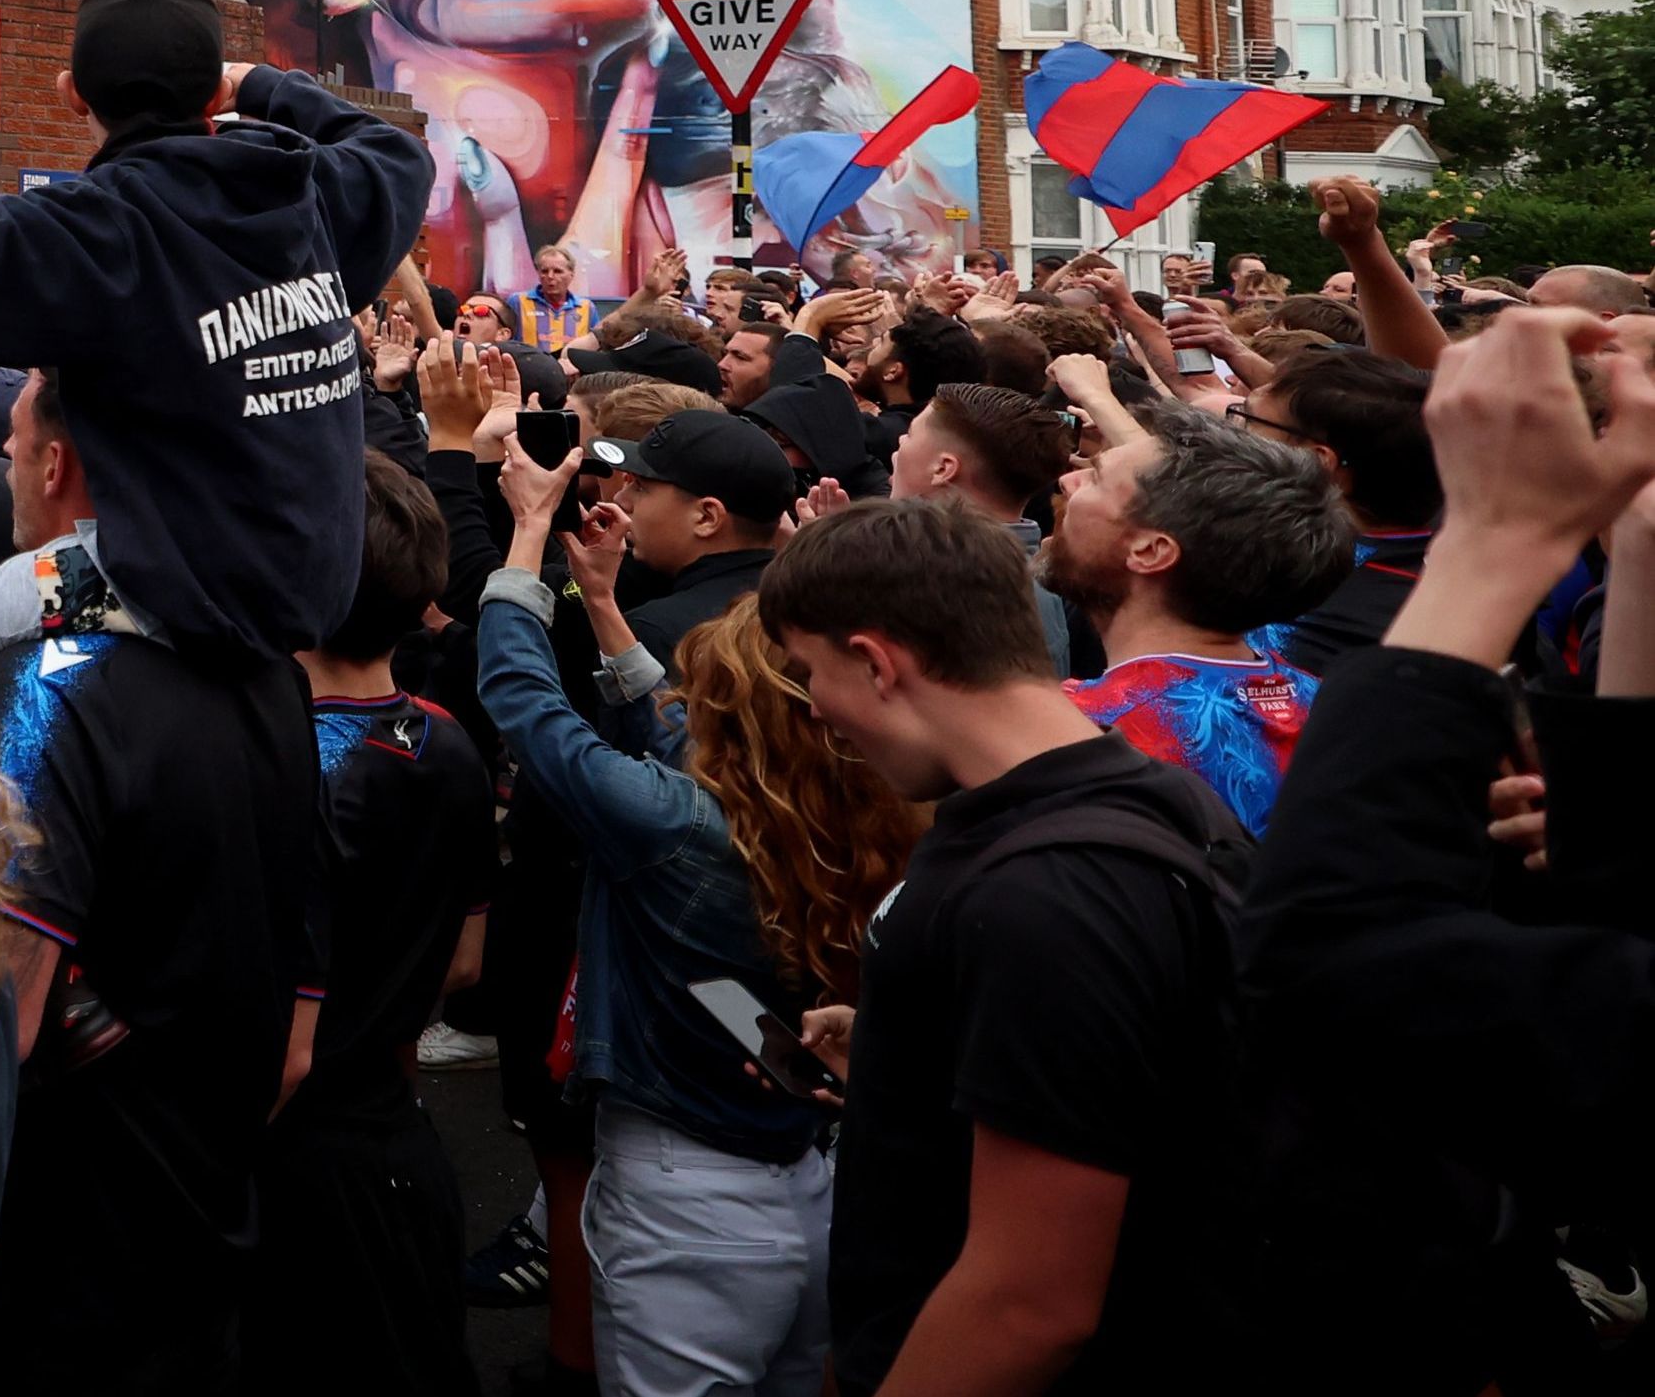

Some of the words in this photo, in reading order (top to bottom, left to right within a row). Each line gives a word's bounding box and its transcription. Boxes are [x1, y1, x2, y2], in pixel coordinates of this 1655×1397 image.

[690, 0, 775, 26] GIVE
[709, 33, 763, 51] WAY
[1237, 683, 1297, 702] SELHURST
[1259, 701, 1290, 711] PARK
